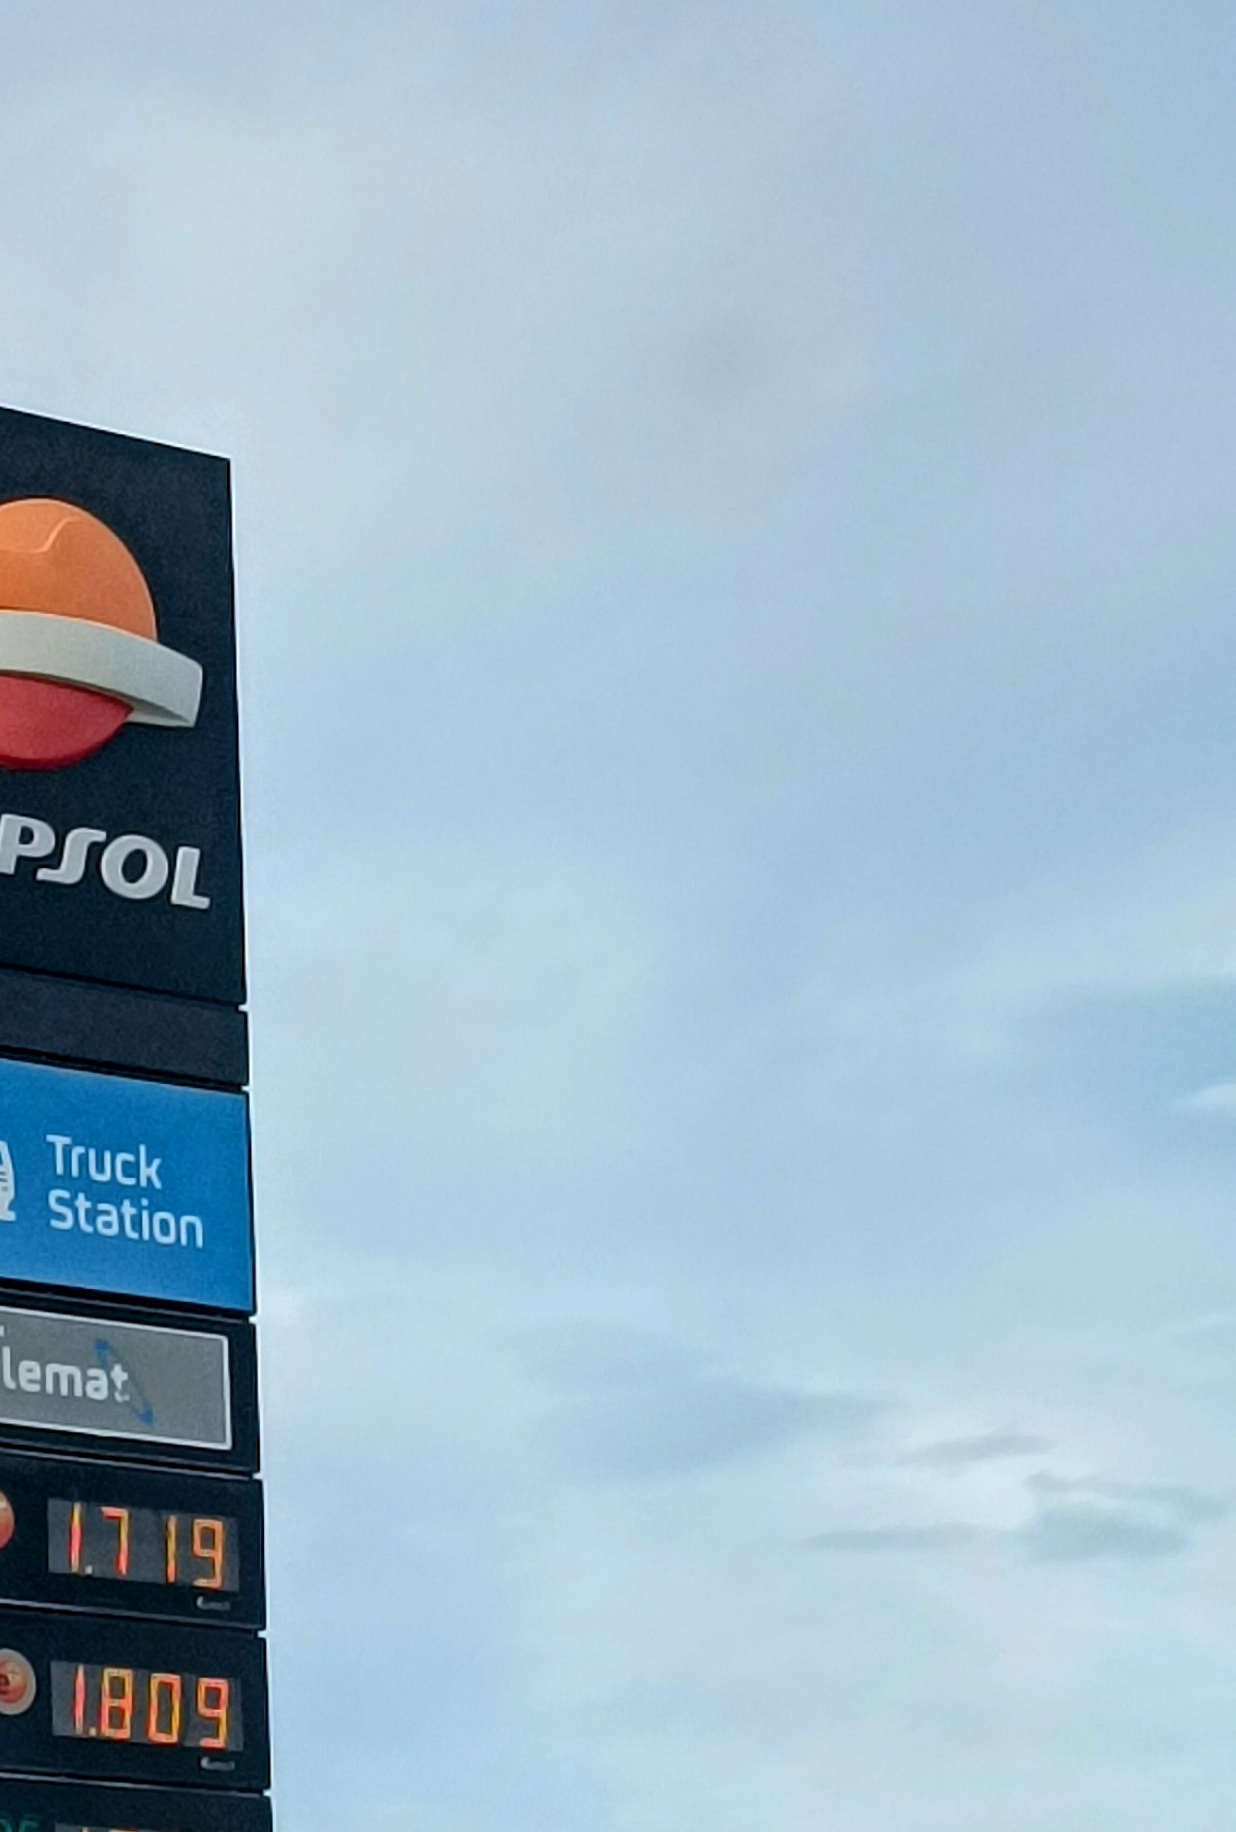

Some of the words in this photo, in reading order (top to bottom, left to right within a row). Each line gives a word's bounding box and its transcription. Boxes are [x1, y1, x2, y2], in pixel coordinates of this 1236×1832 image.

[46, 1134, 162, 1189] Truck
[47, 1189, 204, 1249] Station
[68, 1502, 226, 1590] 1.719
[73, 1664, 230, 1750] 1.809
